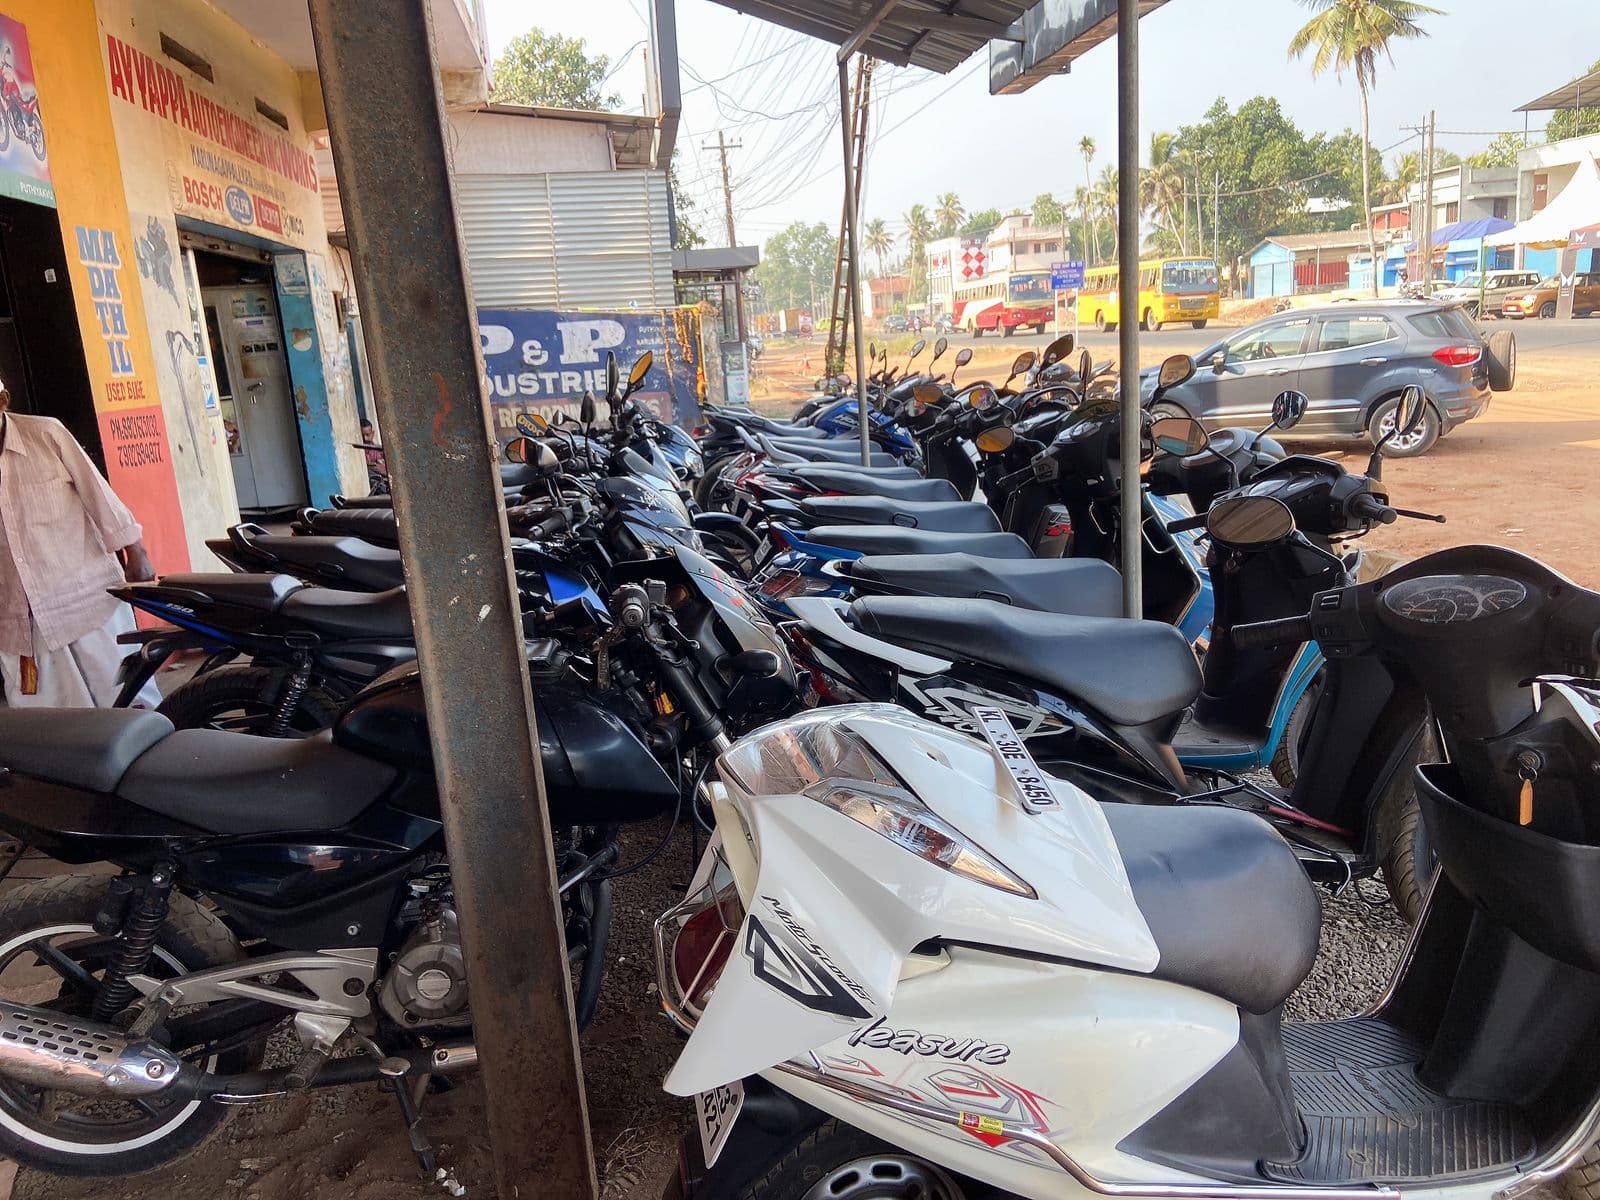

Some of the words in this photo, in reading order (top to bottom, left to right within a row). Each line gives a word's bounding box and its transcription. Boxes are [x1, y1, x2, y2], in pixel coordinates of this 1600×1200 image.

[183, 176, 224, 212] BOSCH
[557, 320, 626, 365] P
[105, 382, 126, 402] USED
[127, 380, 146, 400] BIKE
[848, 1015, 1011, 1065] leasure
